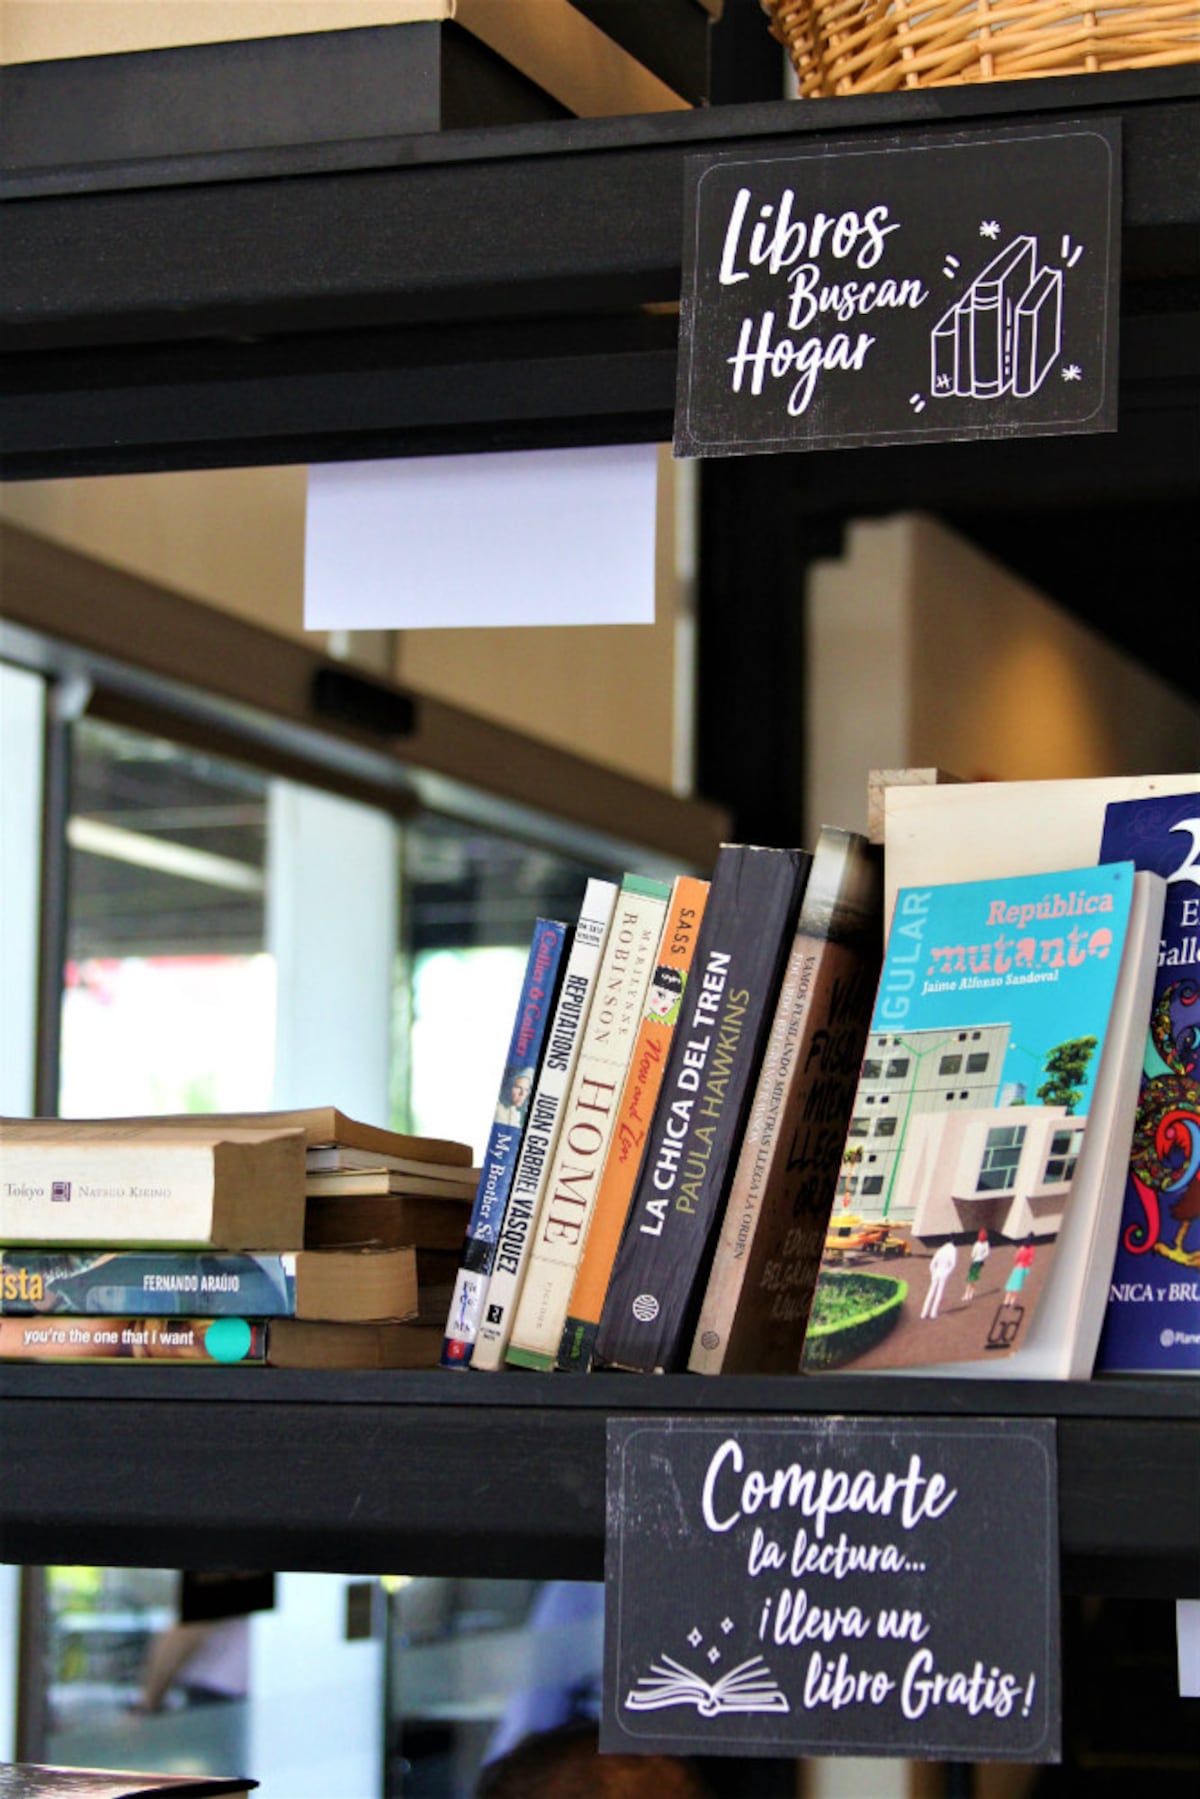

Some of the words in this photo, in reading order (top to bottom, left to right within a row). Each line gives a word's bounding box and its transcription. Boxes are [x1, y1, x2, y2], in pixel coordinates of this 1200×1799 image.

[719, 188, 900, 286] Libros
[787, 263, 928, 330] Buscan
[727, 311, 876, 417] Hogar
[986, 890, 1114, 928] República
[595, 912, 638, 1043] ROBINSON
[926, 925, 1113, 976] mutante
[528, 987, 545, 1000] &
[619, 929, 652, 1034] MARILYNNE
[692, 950, 732, 1031] TREN
[796, 956, 816, 1001] VAMOS
[921, 980, 957, 996] Jaime
[959, 976, 1003, 990] Alfonso
[1005, 969, 1059, 986] Sandoval
[546, 974, 588, 1072] REPUTATIONS
[638, 1038, 664, 1085] Now
[677, 1035, 711, 1093] DEL
[531, 1093, 560, 1134] JUAN
[629, 1086, 643, 1123] and
[675, 1124, 717, 1215] PAULA
[701, 988, 750, 1118] HAWKINS
[761, 1080, 785, 1146] MIENTRAS
[490, 1131, 513, 1160] My
[515, 1134, 549, 1194] GABRIEL
[543, 1075, 616, 1246] HOME
[618, 1122, 645, 1164] Zen
[653, 1098, 694, 1191] CHICA
[750, 1149, 769, 1191] LLEGA
[5, 1183, 45, 1201] Tokyo
[479, 1162, 506, 1218] Brother
[744, 1192, 758, 1211] LA
[497, 1198, 534, 1276] VÁSQUEZ
[640, 1198, 670, 1237] LA
[733, 1214, 753, 1260] ORDEN
[143, 1274, 199, 1292] FERNANDO
[200, 1274, 240, 1292] ARAÚJO
[24, 1328, 66, 1345] you're
[69, 1328, 92, 1344] the
[93, 1331, 119, 1344] one
[121, 1329, 149, 1344] that
[151, 1331, 157, 1344] I
[160, 1331, 194, 1345] want
[702, 1439, 958, 1539] Comparte
[748, 1527, 786, 1576] la
[790, 1527, 926, 1579] lectura...
[759, 1588, 870, 1646] ¡lleva
[877, 1607, 931, 1642] un
[803, 1651, 896, 1710] libro
[900, 1649, 1036, 1719] Gratis!
